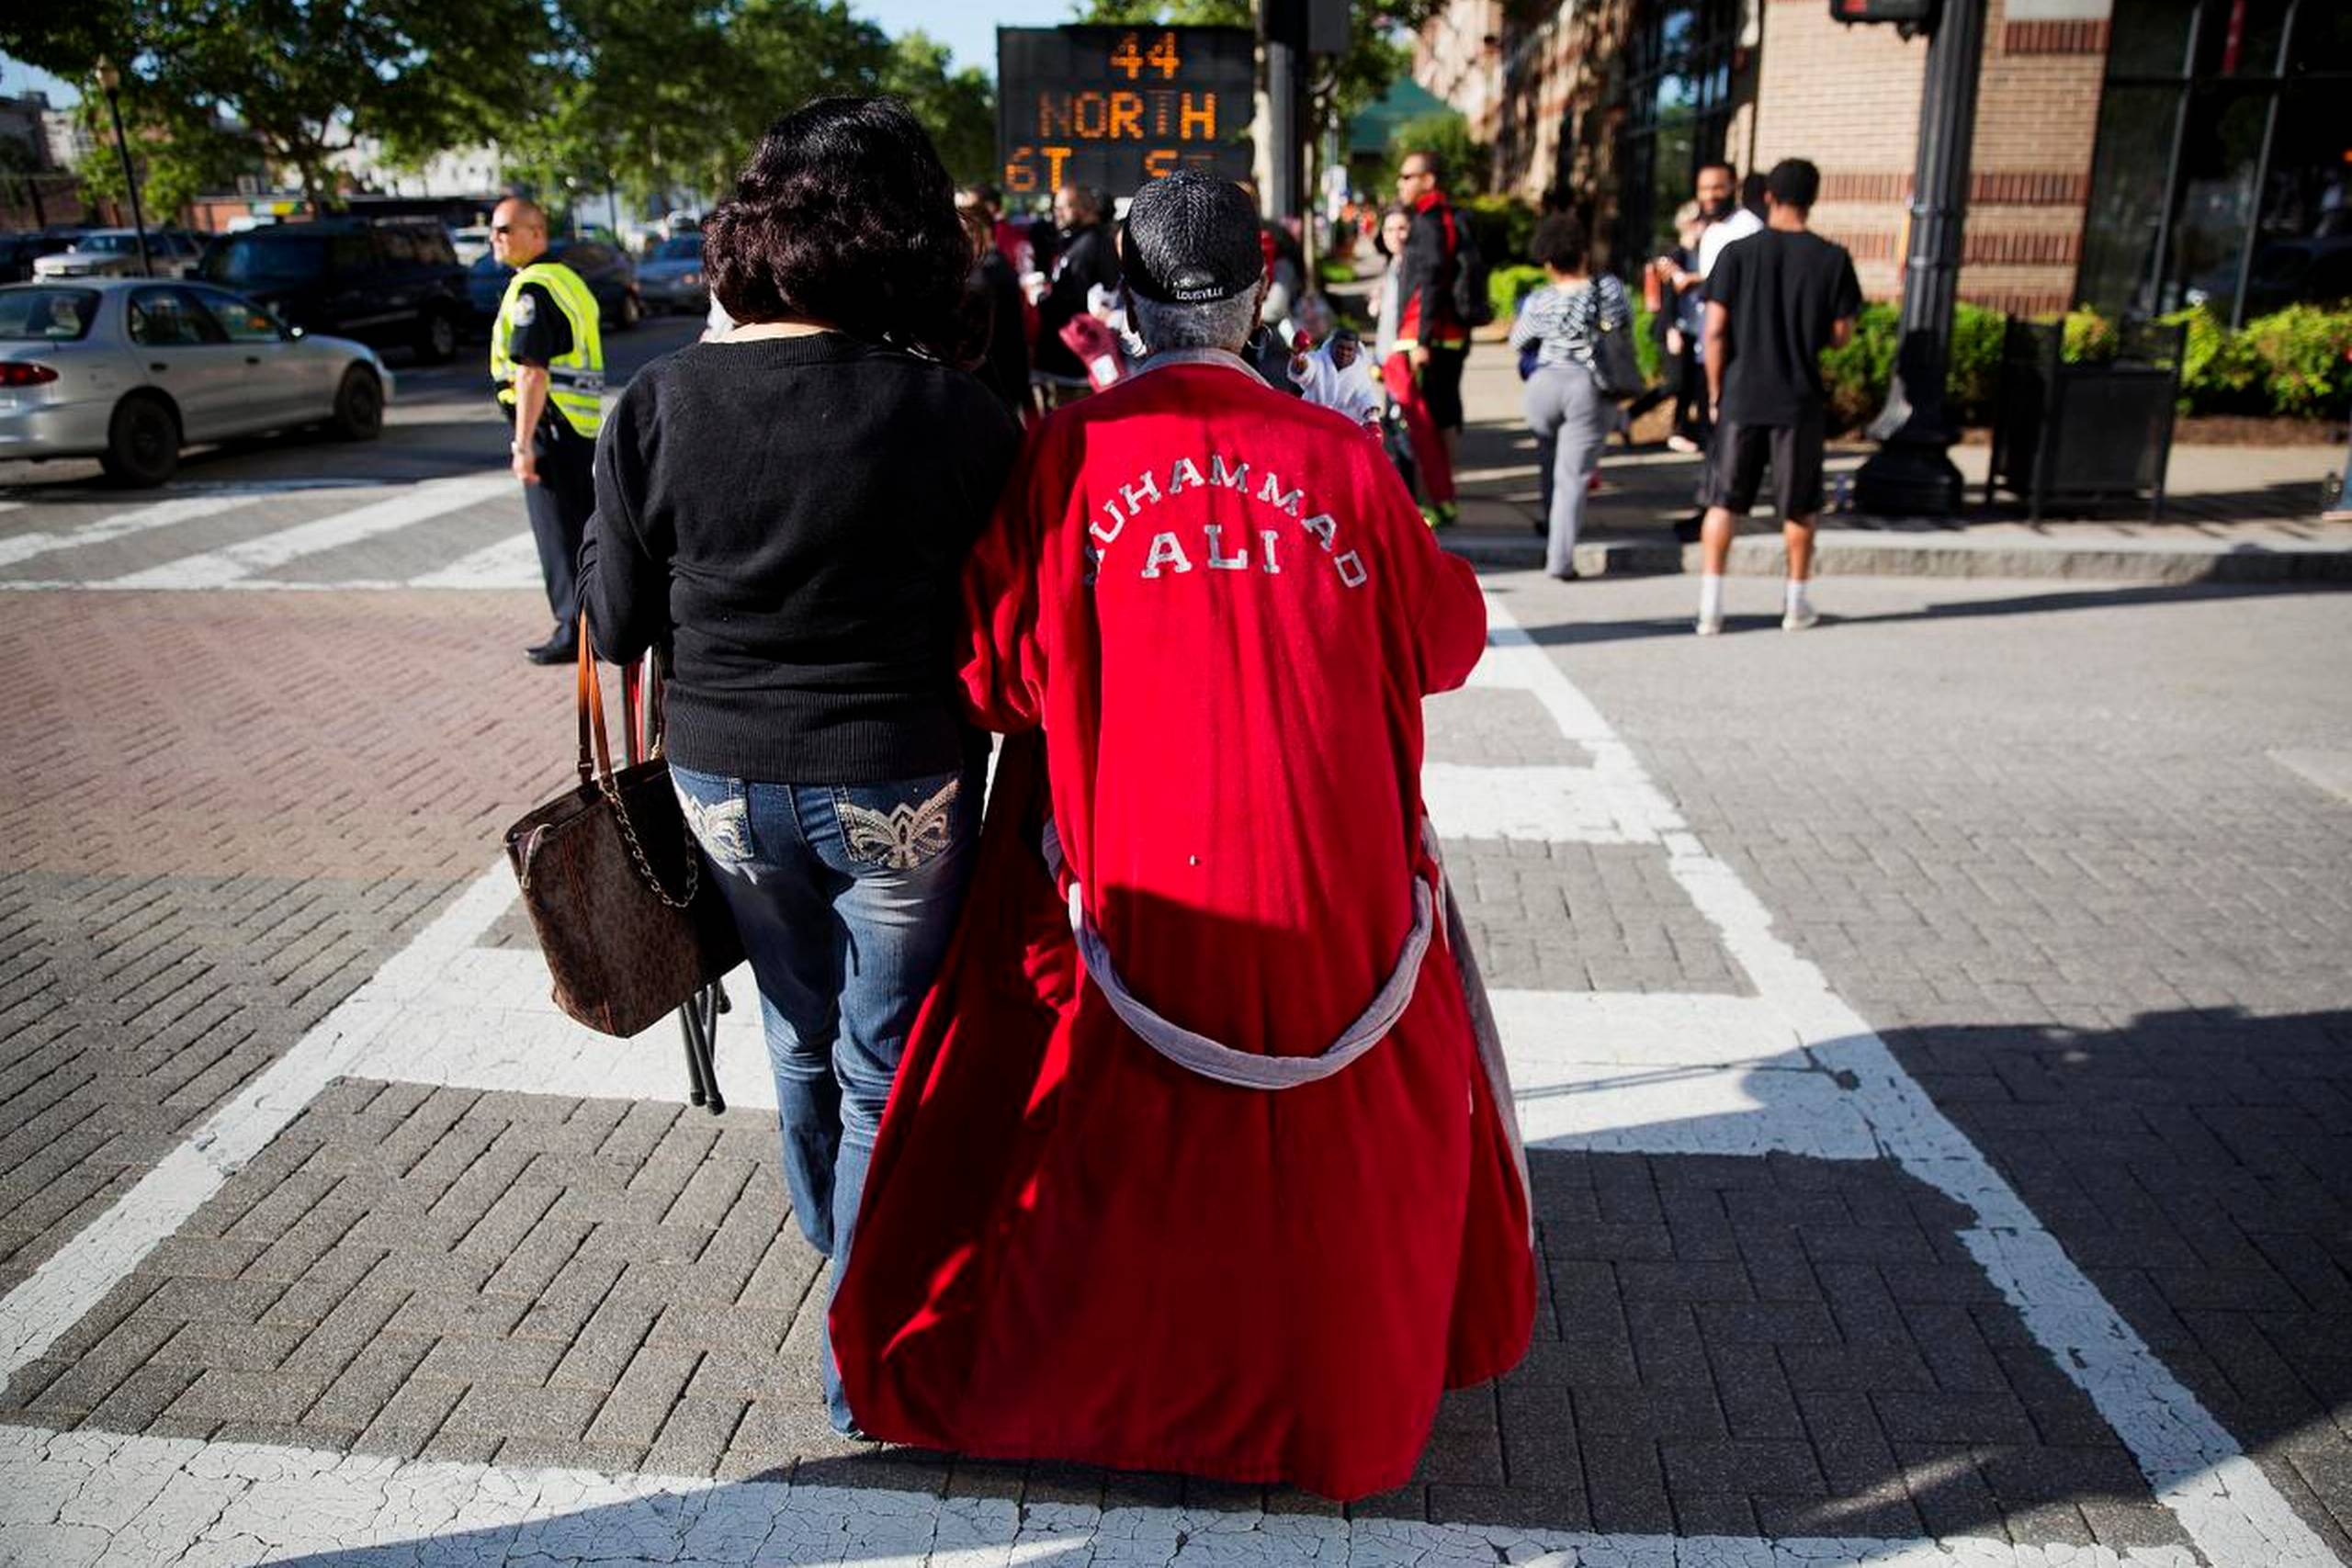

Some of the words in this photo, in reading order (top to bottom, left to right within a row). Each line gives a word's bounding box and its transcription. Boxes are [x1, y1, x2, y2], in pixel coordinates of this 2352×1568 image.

[1109, 31, 1182, 80] 44
[1037, 91, 1217, 140] NORTH
[1176, 286, 1223, 300] LOUISVILLE
[1141, 523, 1281, 578] ALI
